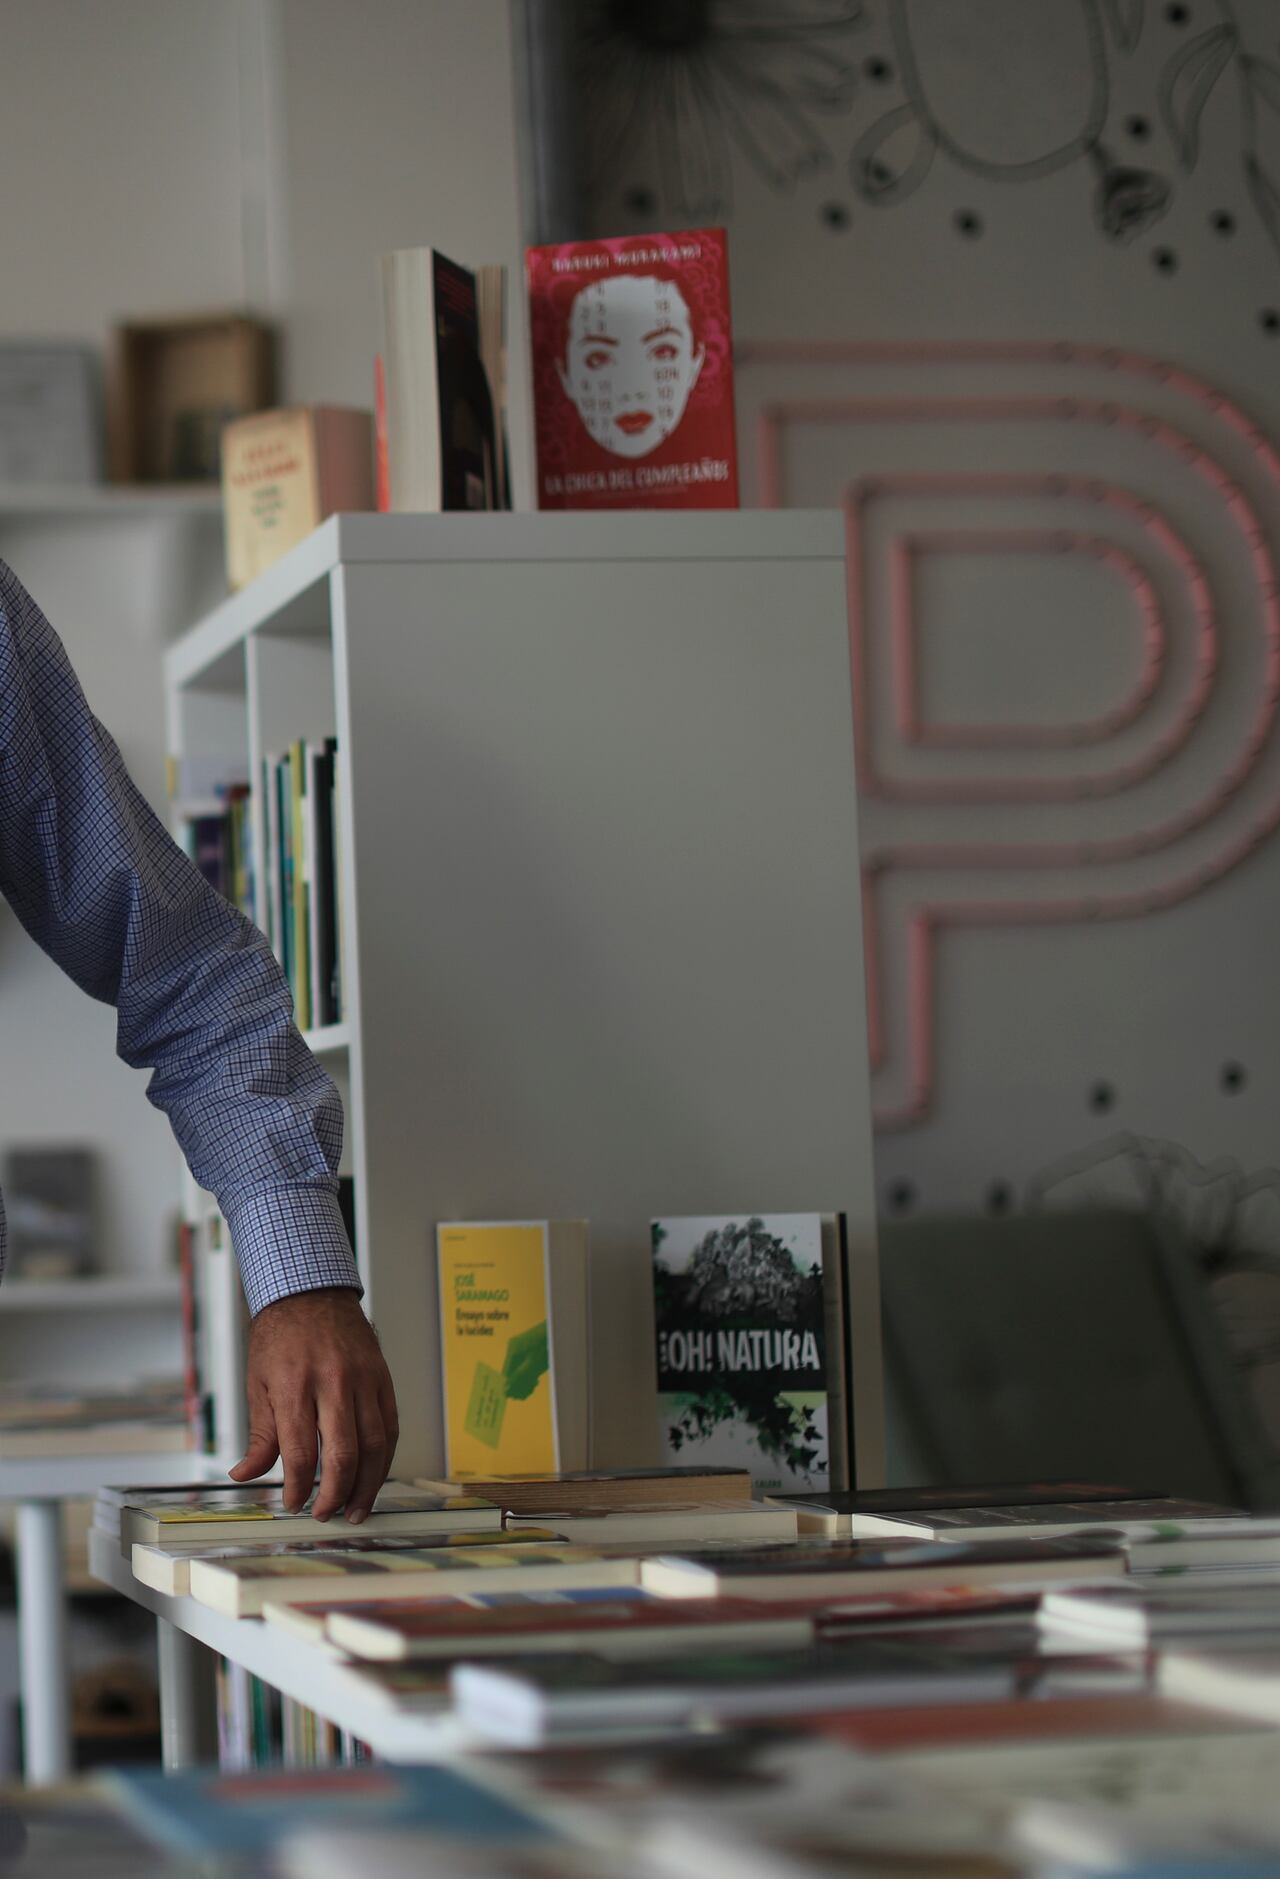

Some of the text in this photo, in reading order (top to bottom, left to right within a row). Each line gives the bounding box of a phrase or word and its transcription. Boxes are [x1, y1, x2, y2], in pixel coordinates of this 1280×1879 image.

[565, 470, 606, 494] CHICA
[608, 467, 634, 490] DEL
[636, 456, 729, 488] CUMPLEAÑOS
[738, 340, 1280, 1125] P
[454, 1271, 476, 1289] JOSÉ
[455, 1288, 510, 1303] SARAMAGO
[456, 1306, 510, 1323] Ensayo sobre
[457, 1324, 495, 1337] la lucidez
[717, 1328, 822, 1372] NATURA
